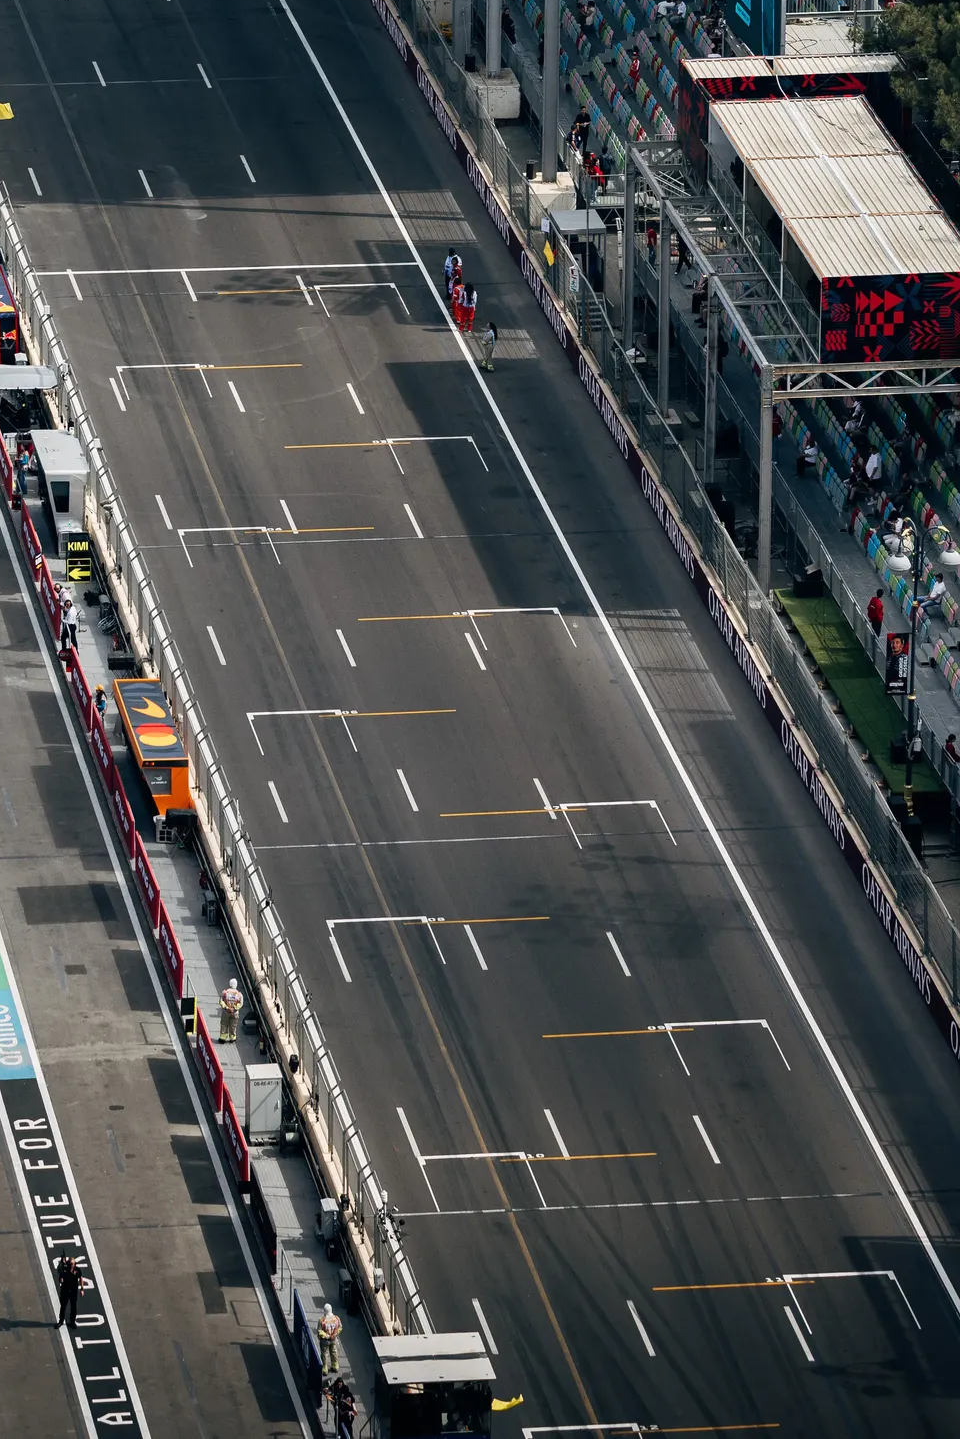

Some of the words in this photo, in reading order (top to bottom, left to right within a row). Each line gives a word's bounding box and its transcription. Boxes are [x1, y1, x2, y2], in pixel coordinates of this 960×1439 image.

[417, 64, 435, 110] QATAR
[466, 152, 486, 204] QATAR
[485, 187, 510, 246] AIRWAYS
[521, 252, 541, 300] QATAR
[541, 288, 567, 349] AIRWAYS
[579, 354, 600, 409] QATAR
[600, 397, 629, 459] AIRWAYS
[68, 542, 89, 551] KIMI
[641, 466, 664, 524] QATAR
[664, 512, 695, 579] AIRWAYS
[708, 587, 734, 651] QATAR
[734, 636, 767, 709] AIRWAYS
[781, 720, 808, 788] QATAR
[809, 772, 845, 850] AIRWAYS
[862, 863, 892, 937] QATAR
[893, 921, 931, 1005] AIRWAYS
[14, 1118, 58, 1170] FOR
[74, 1313, 111, 1349] TO
[86, 1367, 134, 1425] ALL
